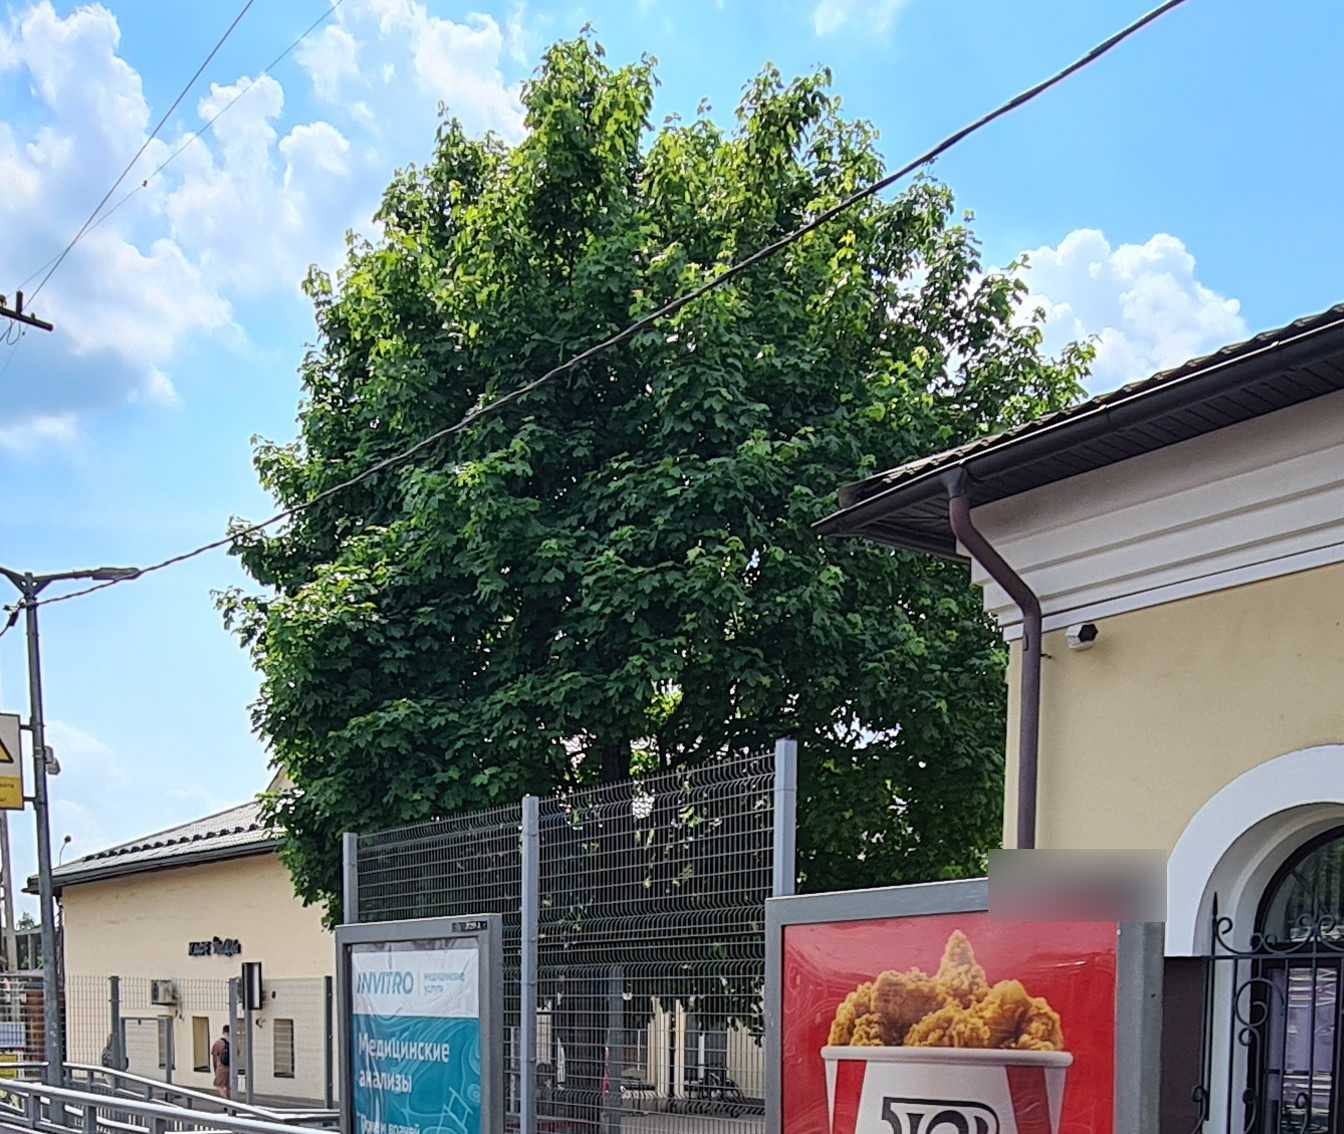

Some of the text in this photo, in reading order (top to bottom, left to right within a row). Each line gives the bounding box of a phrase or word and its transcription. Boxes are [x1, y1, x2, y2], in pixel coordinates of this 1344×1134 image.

[357, 970, 415, 995] INVITRO
[358, 1032, 450, 1063] Медицинские
[359, 1069, 413, 1094] анализы
